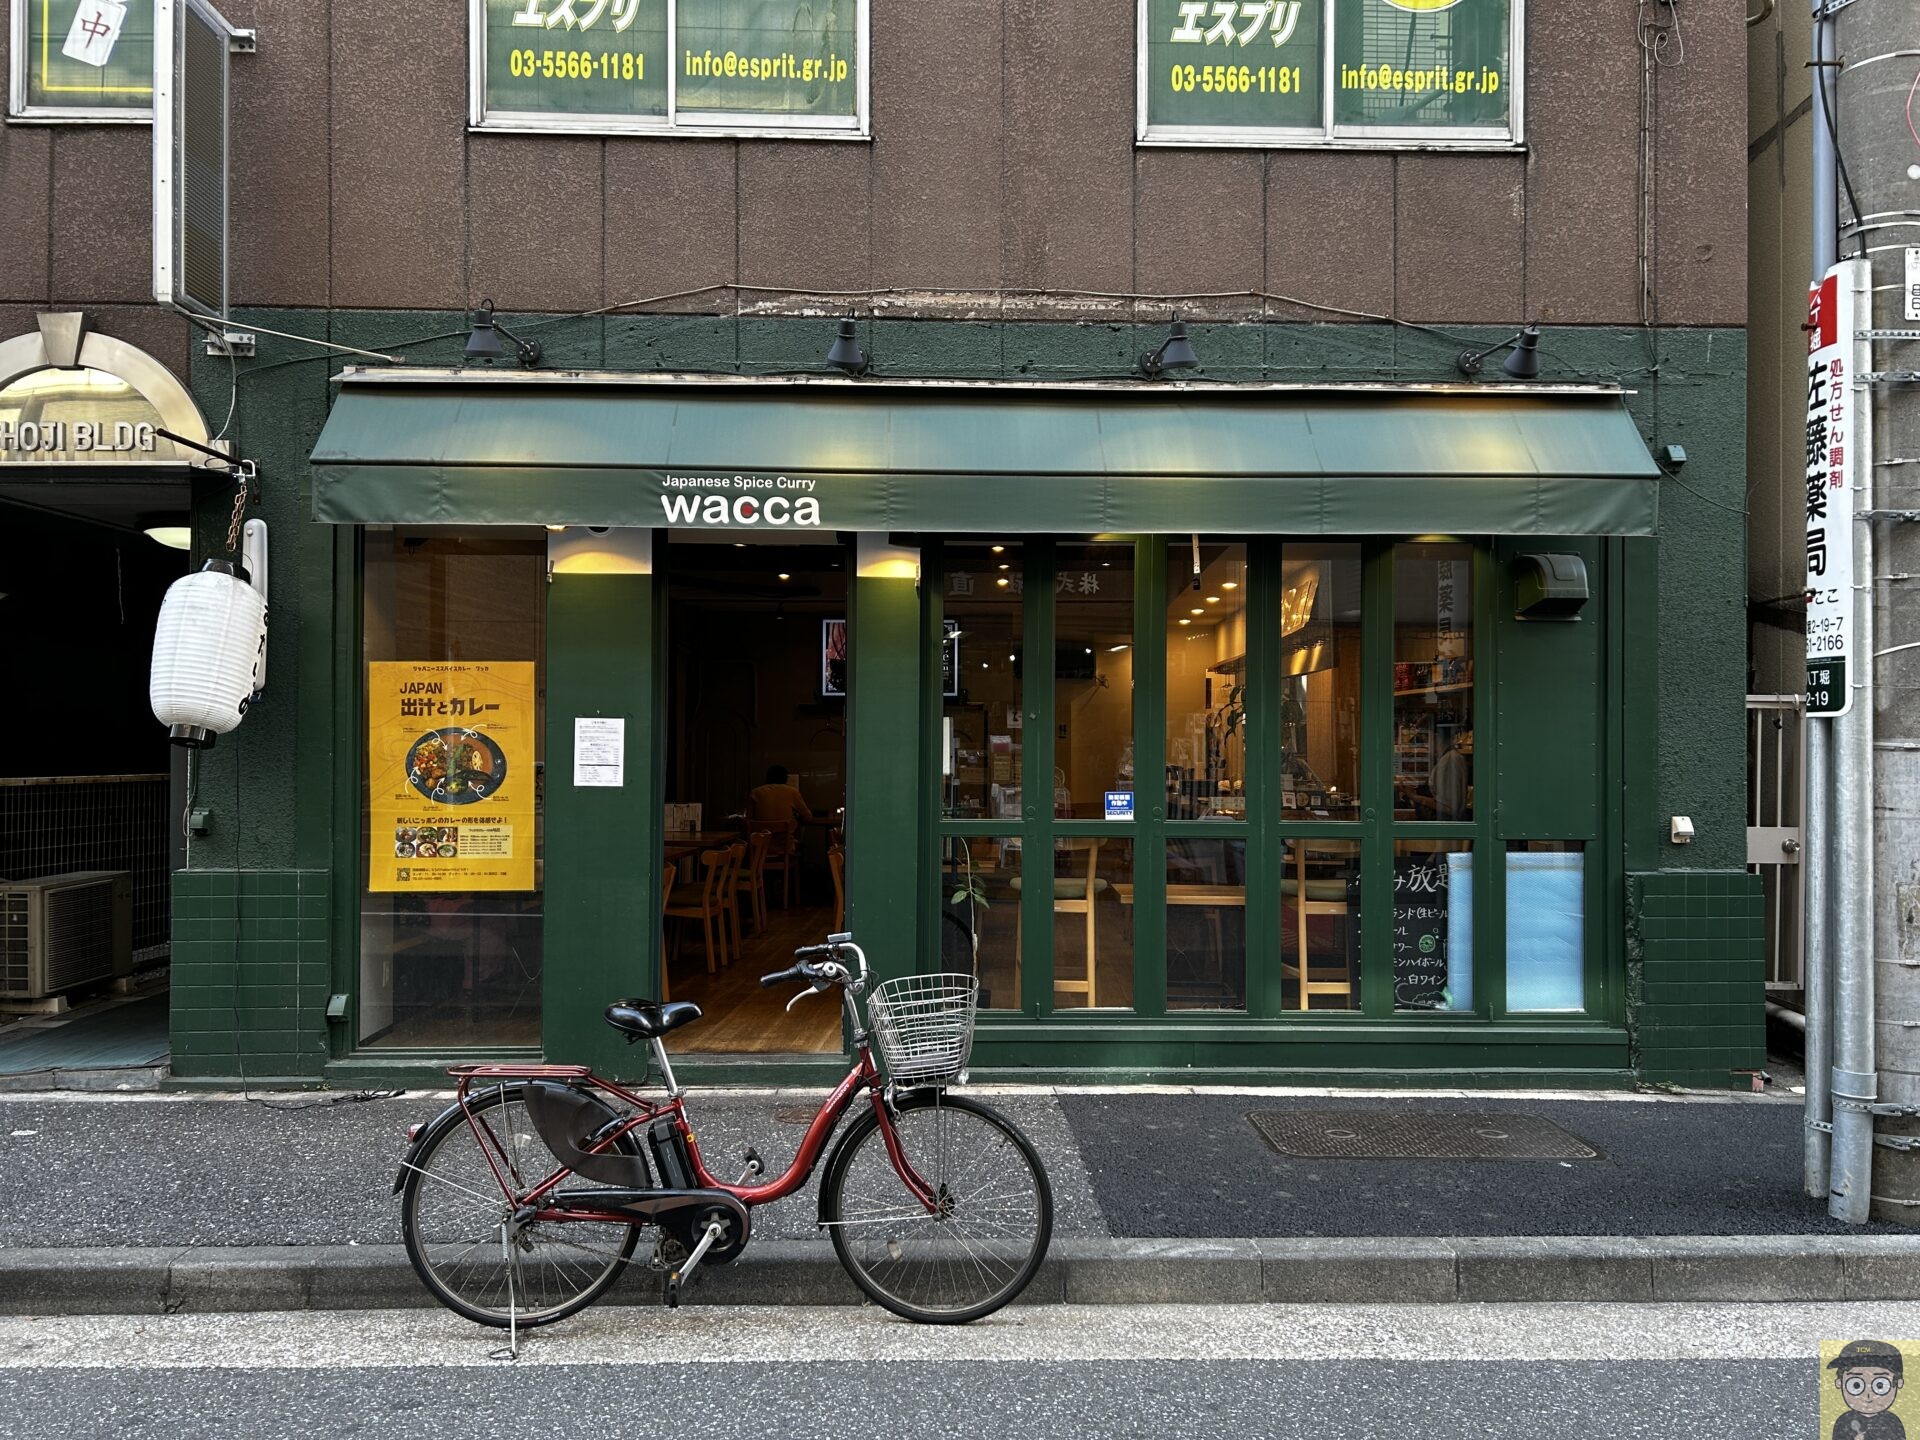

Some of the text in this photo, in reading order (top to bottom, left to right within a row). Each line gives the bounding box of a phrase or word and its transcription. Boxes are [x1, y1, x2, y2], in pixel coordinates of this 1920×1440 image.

[81, 12, 111, 49] 中
[1170, 0, 1301, 48] エスプリ
[510, 49, 645, 80] 03-5566-1181
[685, 50, 848, 82] info@esprit.gr.jp
[1171, 64, 1301, 93] 03-5566-1181
[1341, 63, 1499, 94] info@esprit.gr.jp
[73, 421, 157, 451] BLDG
[1829, 358, 1844, 490] 処方せん調剤
[662, 474, 816, 492] Japanese Spice Curry
[660, 494, 821, 526] wacca
[399, 682, 443, 695] JAPAN
[400, 698, 501, 717] 出汁とカレー
